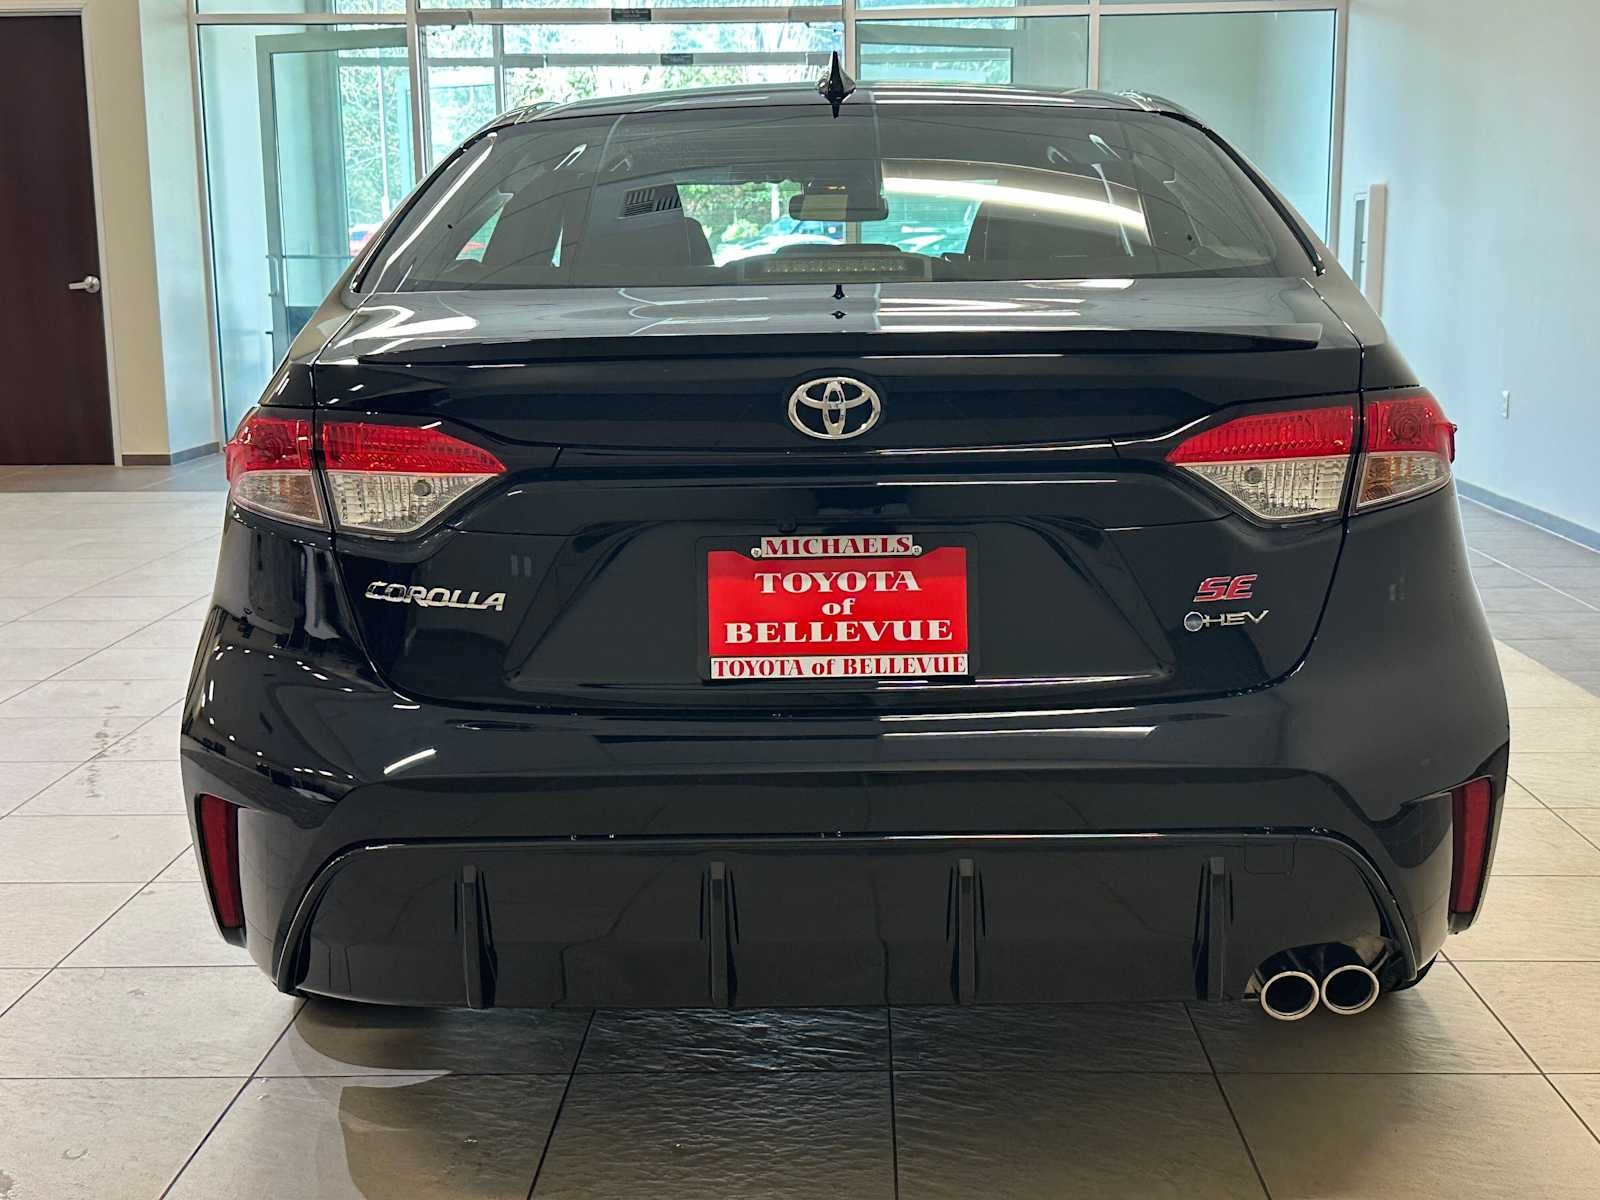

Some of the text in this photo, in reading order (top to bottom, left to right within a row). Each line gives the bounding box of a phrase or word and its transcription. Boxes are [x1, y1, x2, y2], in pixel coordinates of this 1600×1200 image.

[765, 536, 911, 555] MICHAELS
[754, 570, 922, 593] TOYOTA
[1193, 574, 1258, 602] SE
[365, 581, 506, 612] COROLLA
[821, 598, 856, 615] of
[724, 619, 953, 644] BELLEVUE
[713, 656, 966, 677] TOYOTA of BELLEVUE
